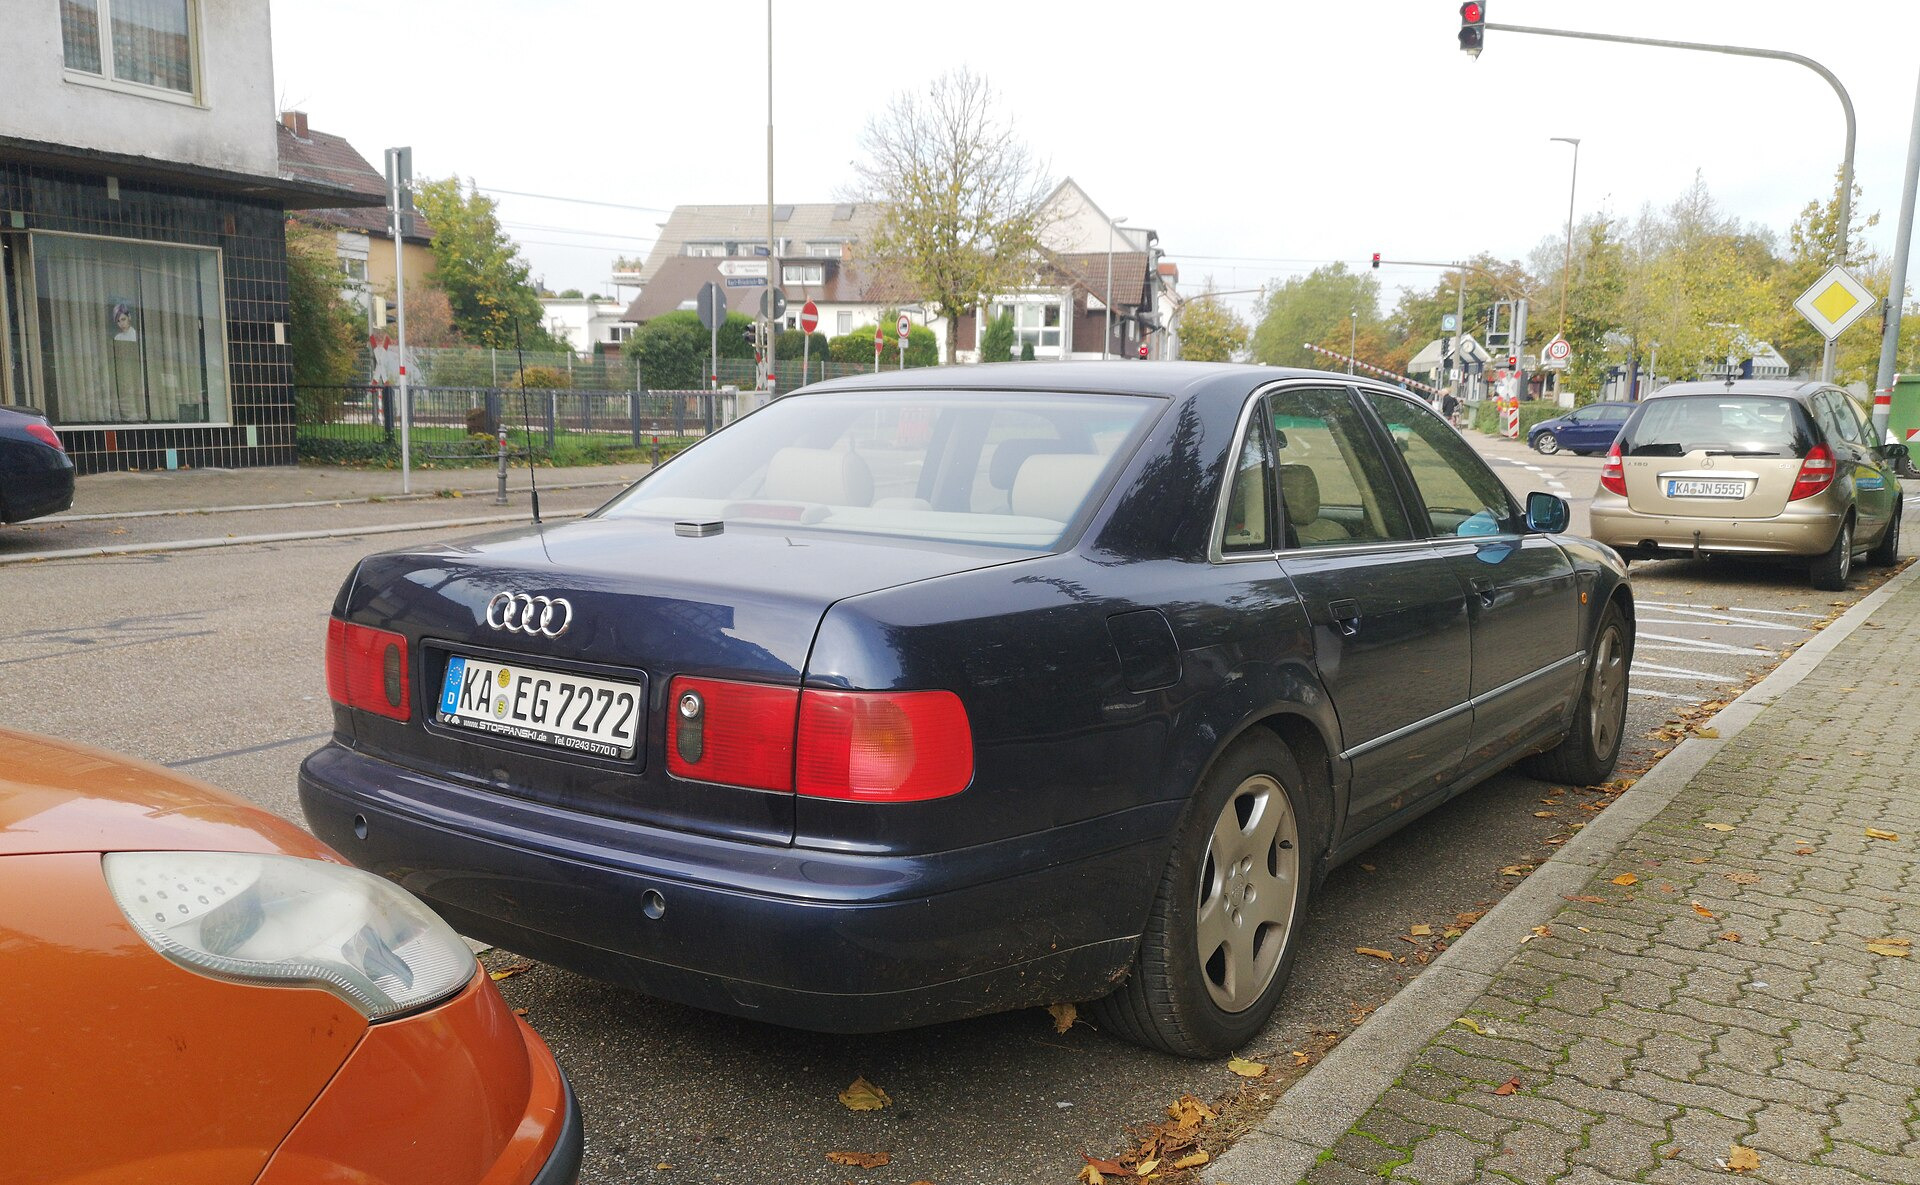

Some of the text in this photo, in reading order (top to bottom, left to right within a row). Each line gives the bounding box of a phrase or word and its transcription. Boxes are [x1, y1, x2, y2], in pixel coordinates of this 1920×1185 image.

[1553, 345, 1566, 355] 30
[1676, 482, 1689, 494] KA
[1698, 483, 1713, 495] JN
[1714, 483, 1743, 495] 5555
[447, 691, 455, 704] D
[460, 666, 634, 739] KA EG 7272
[565, 737, 590, 751] 07243
